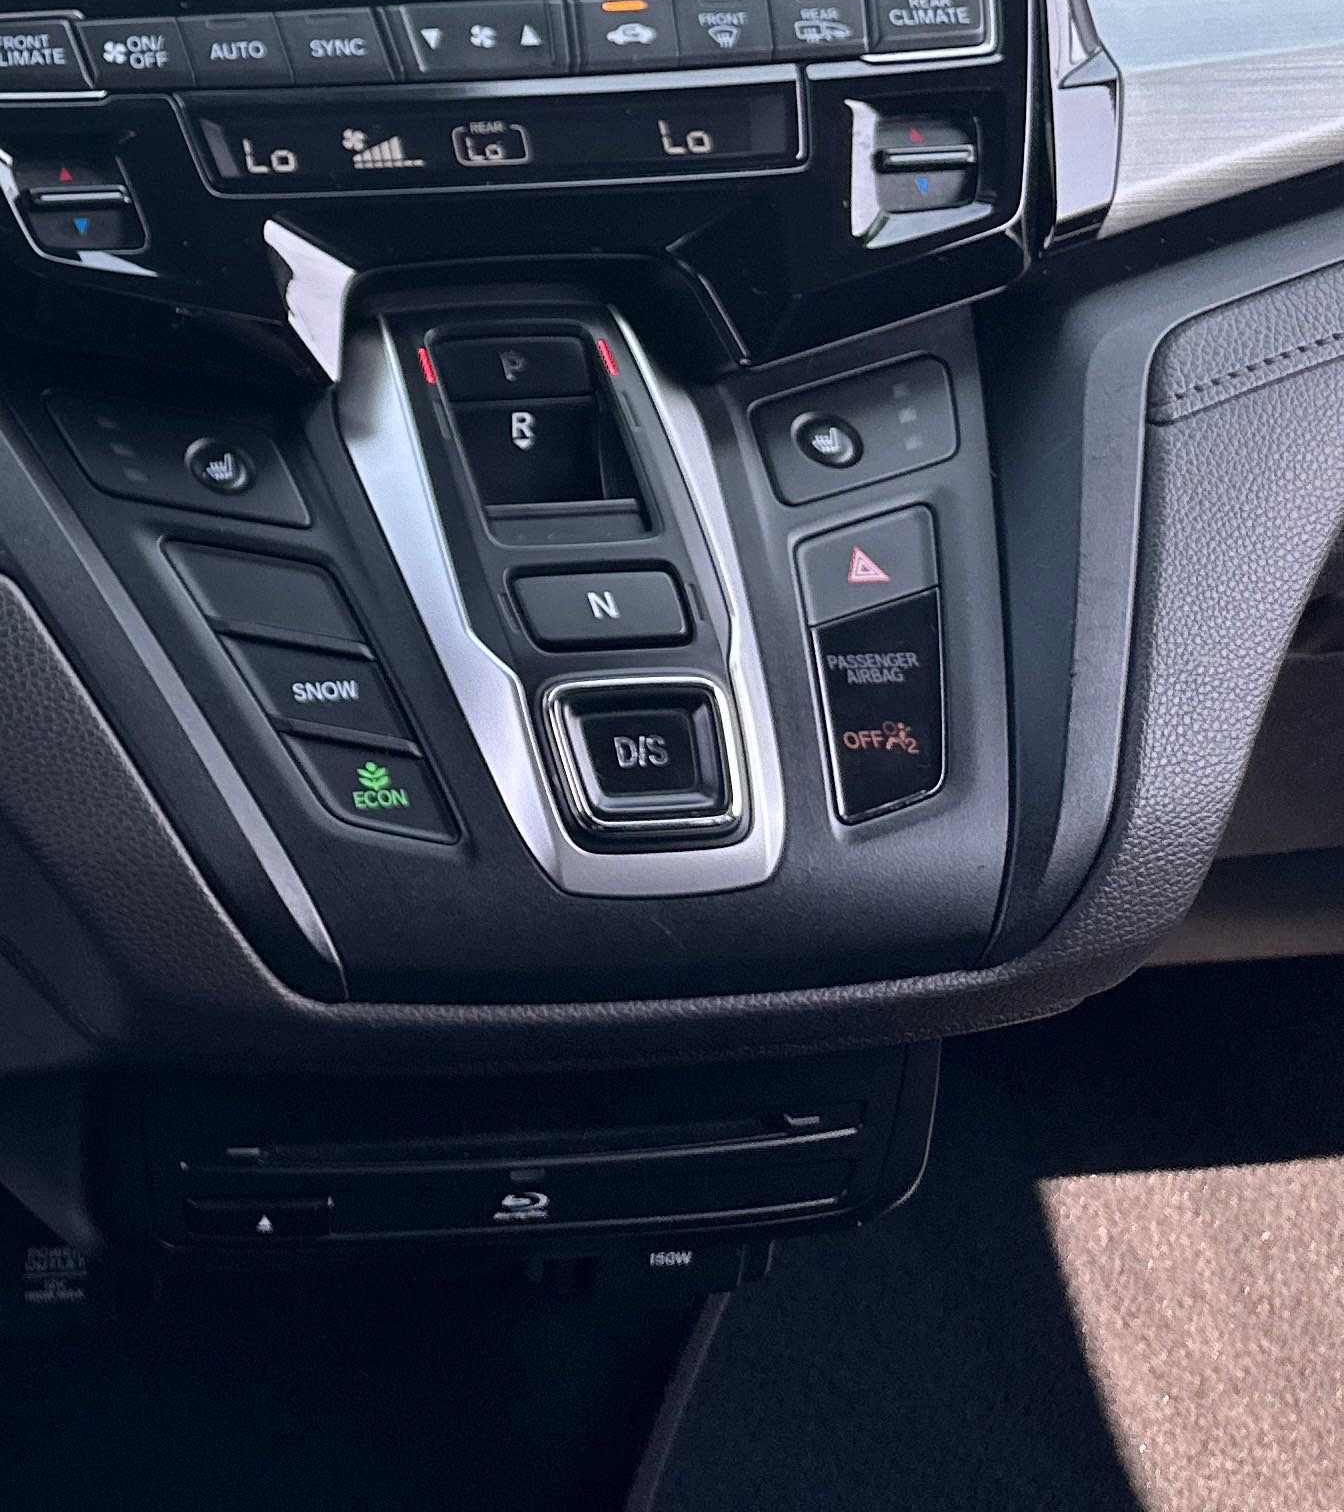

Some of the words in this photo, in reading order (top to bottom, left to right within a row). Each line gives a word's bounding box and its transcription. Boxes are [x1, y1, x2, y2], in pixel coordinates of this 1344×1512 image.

[698, 10, 748, 28] FRONT
[799, 7, 840, 24] REAR
[888, 6, 971, 28] CLIMATE
[209, 40, 266, 62] AUTO
[310, 37, 366, 59] SYNC
[130, 49, 168, 70] OFF
[470, 120, 506, 135] REAR
[658, 119, 712, 156] Lo
[243, 138, 298, 175] Lo
[512, 411, 537, 438] R
[587, 592, 620, 619] N
[827, 652, 920, 671] PASSENGER
[846, 666, 904, 684] AIRBAG
[292, 679, 359, 703] SNOW
[614, 734, 669, 769] D/S
[842, 729, 883, 752] OFF
[353, 789, 409, 809] ECON
